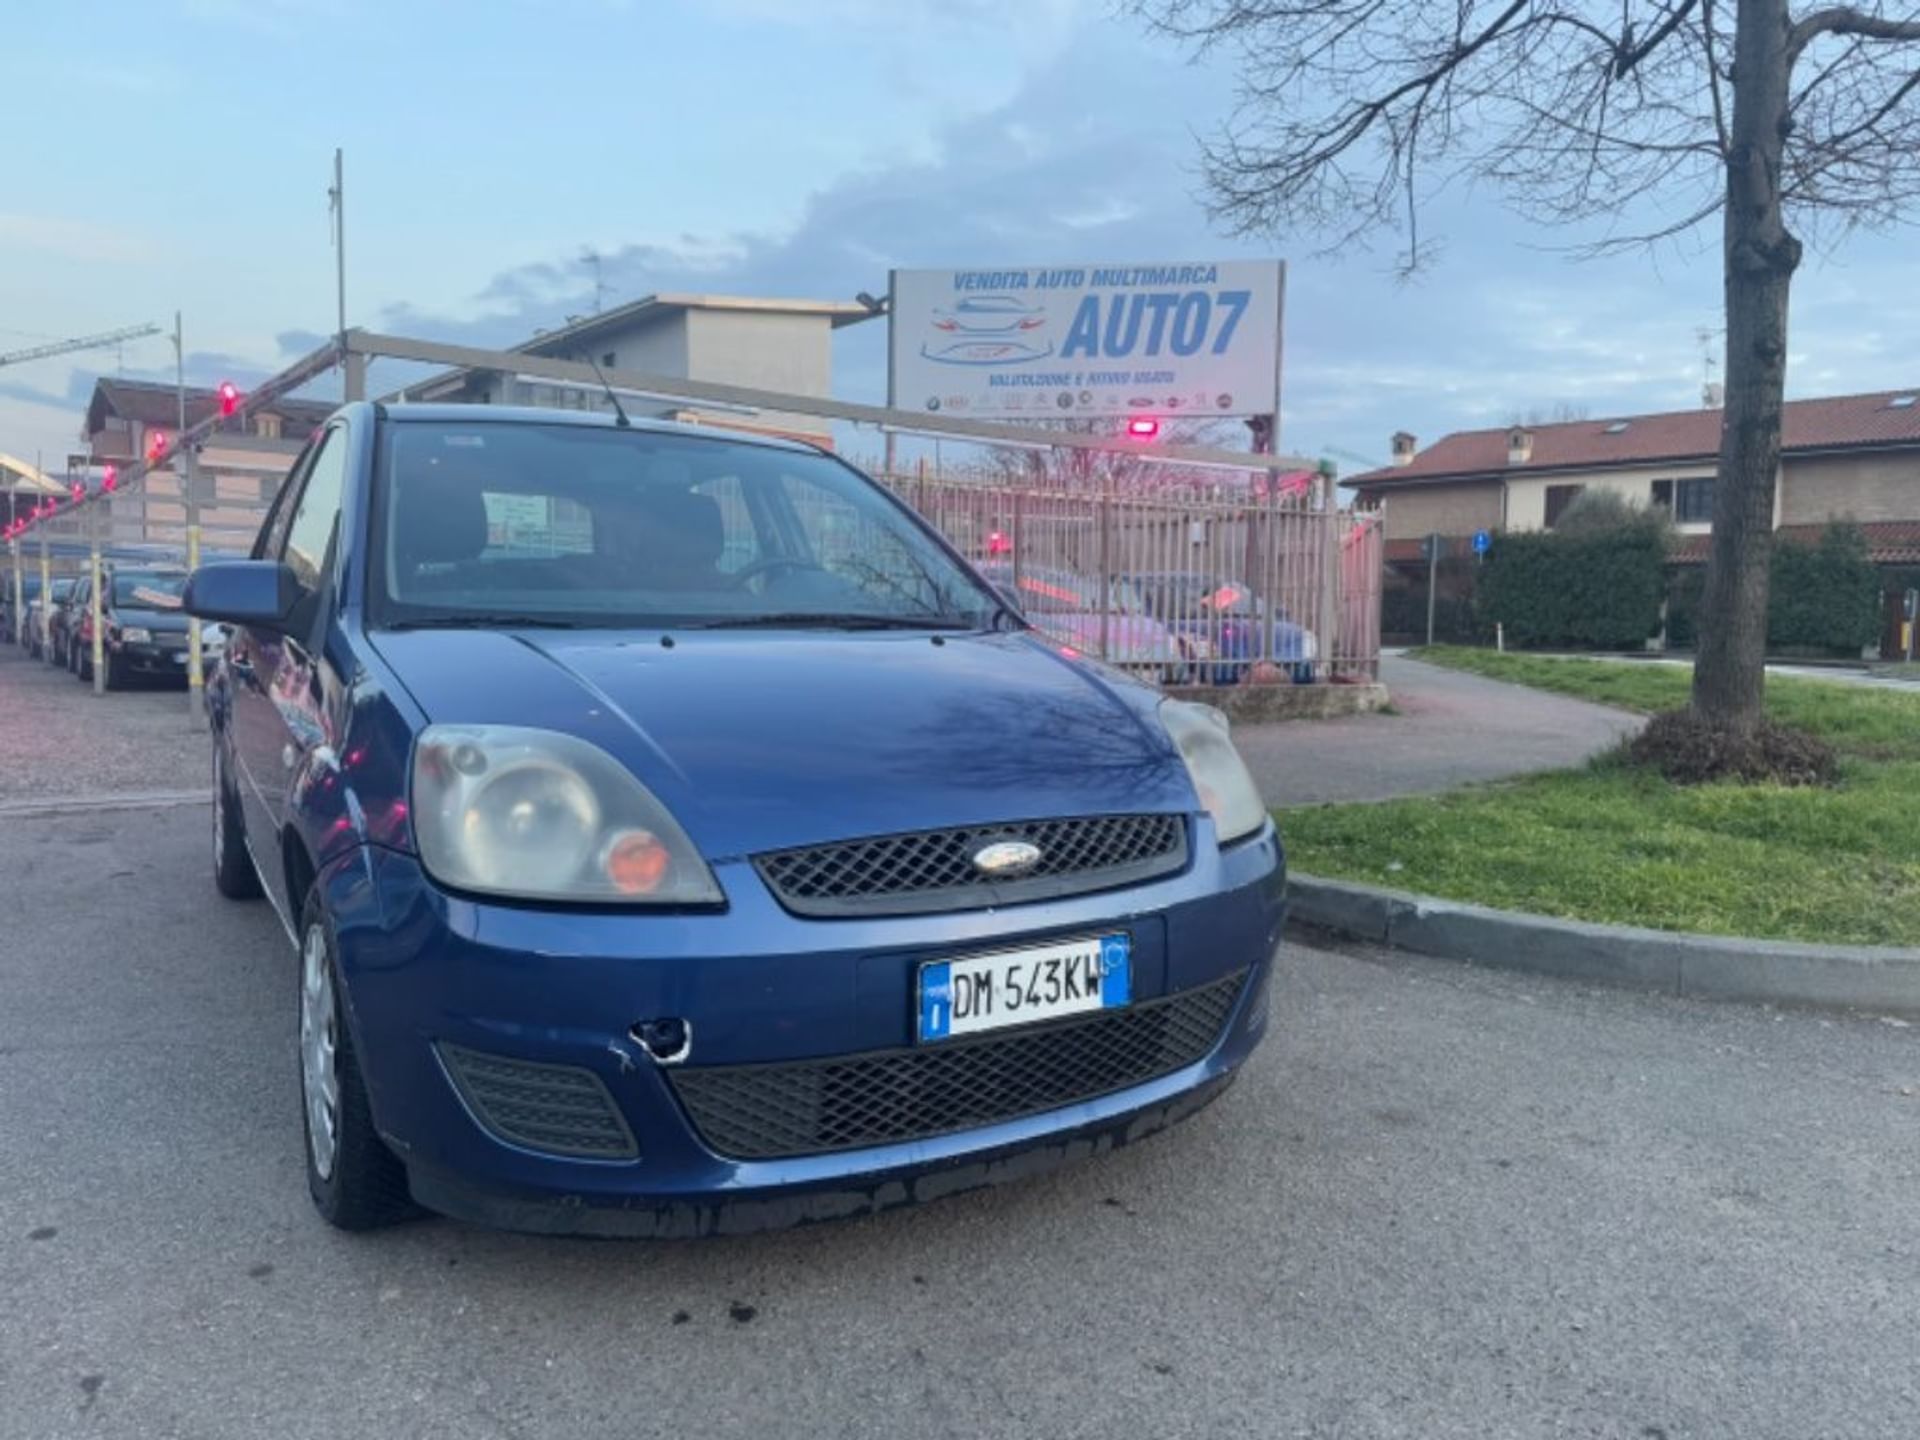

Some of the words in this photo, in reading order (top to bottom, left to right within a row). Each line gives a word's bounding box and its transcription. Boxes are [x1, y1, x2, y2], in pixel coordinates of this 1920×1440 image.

[954, 271, 1029, 291] VENDITA
[1035, 270, 1085, 289] AUTO
[1090, 266, 1217, 287] MULTIMARCA
[1059, 290, 1251, 358] AUTO7
[953, 969, 992, 1019] DM
[1005, 953, 1100, 1011] 543KW
